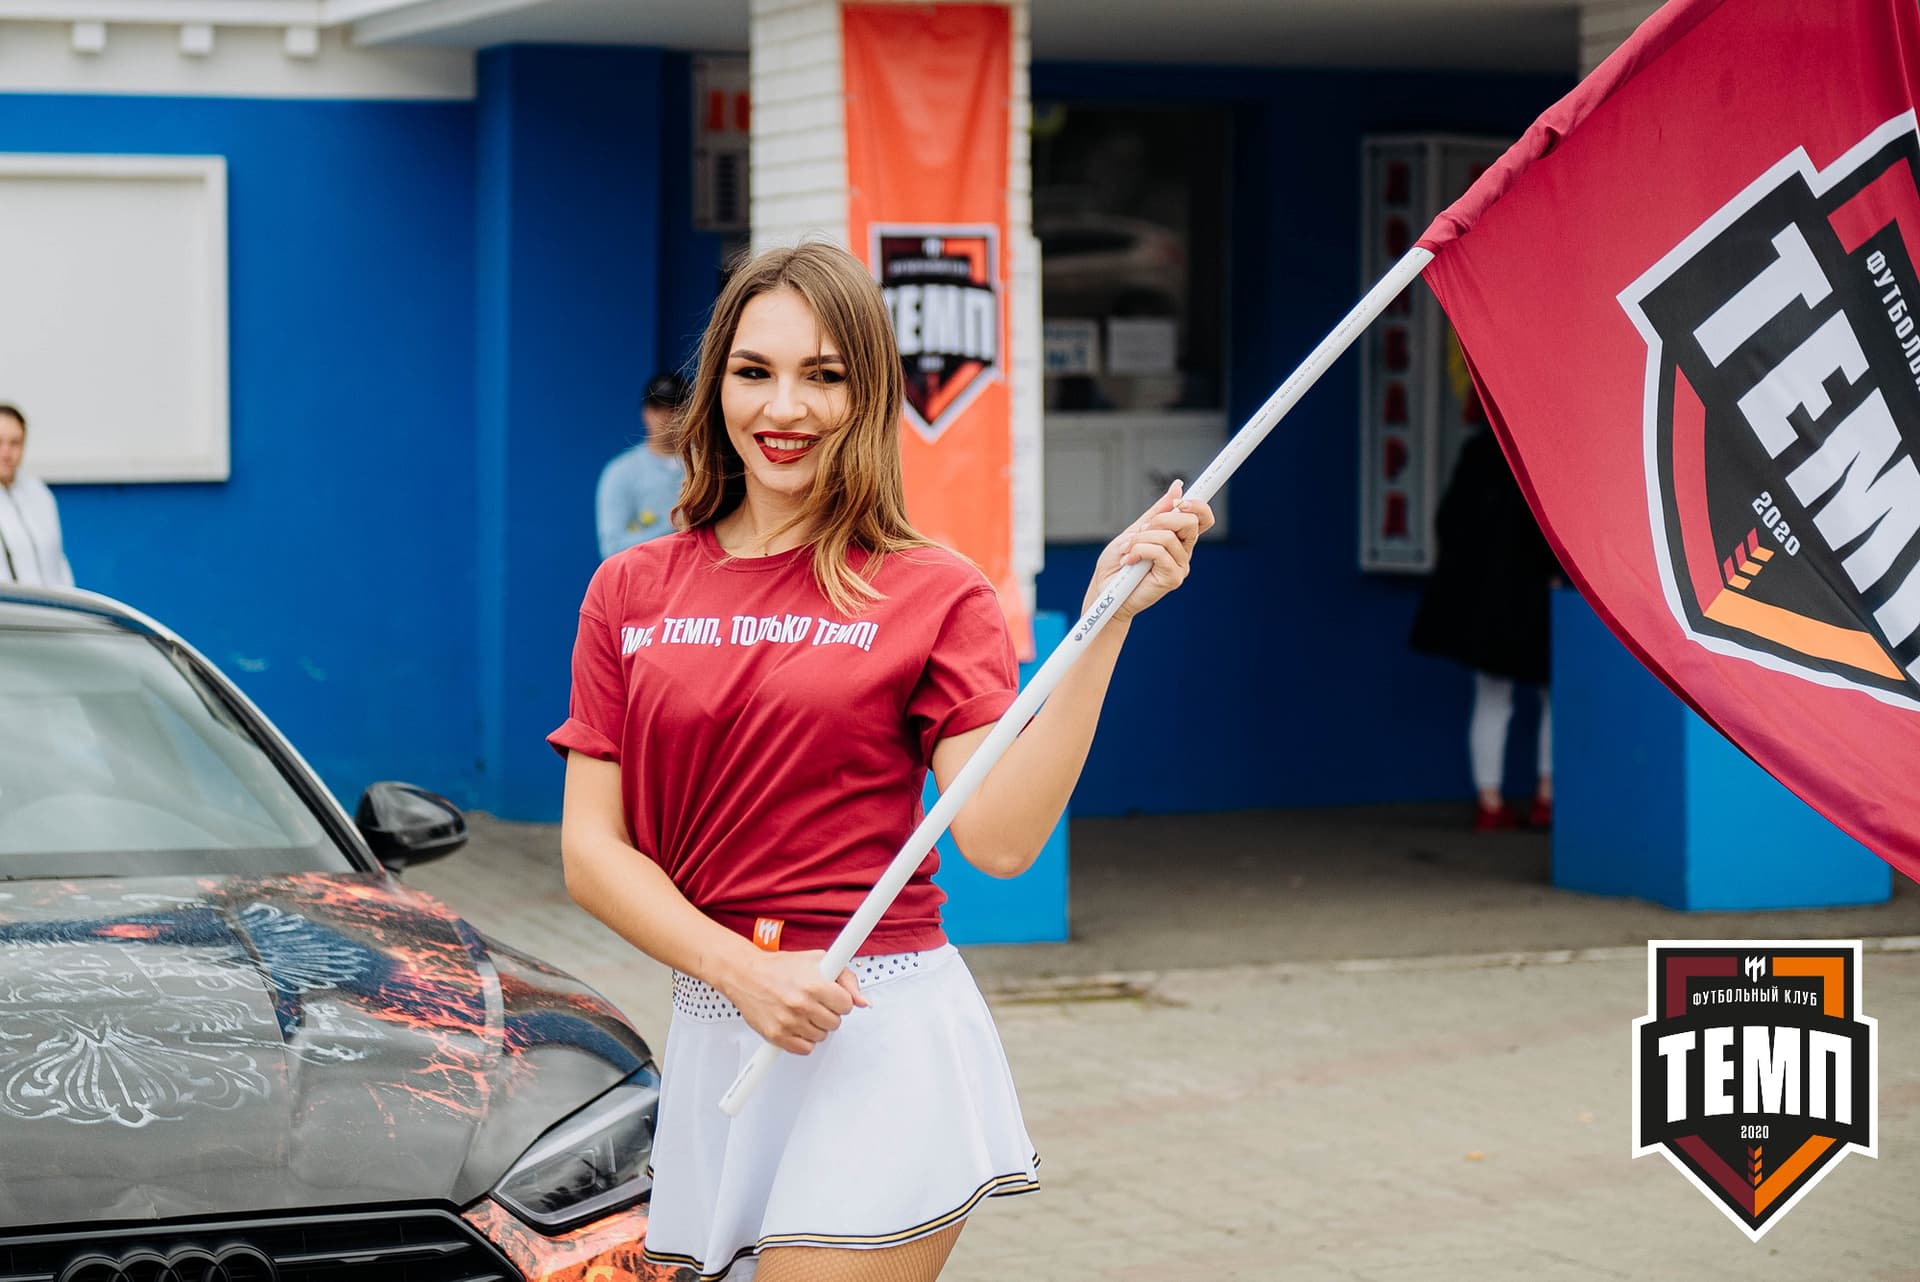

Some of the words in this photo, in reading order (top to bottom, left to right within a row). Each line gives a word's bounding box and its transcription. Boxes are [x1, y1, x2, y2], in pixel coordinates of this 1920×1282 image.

[1751, 491, 1801, 556] 2020
[661, 617, 722, 647] ТЕМП,
[730, 614, 812, 646] ТОЛЬКО
[812, 617, 879, 651] ТЕМП!
